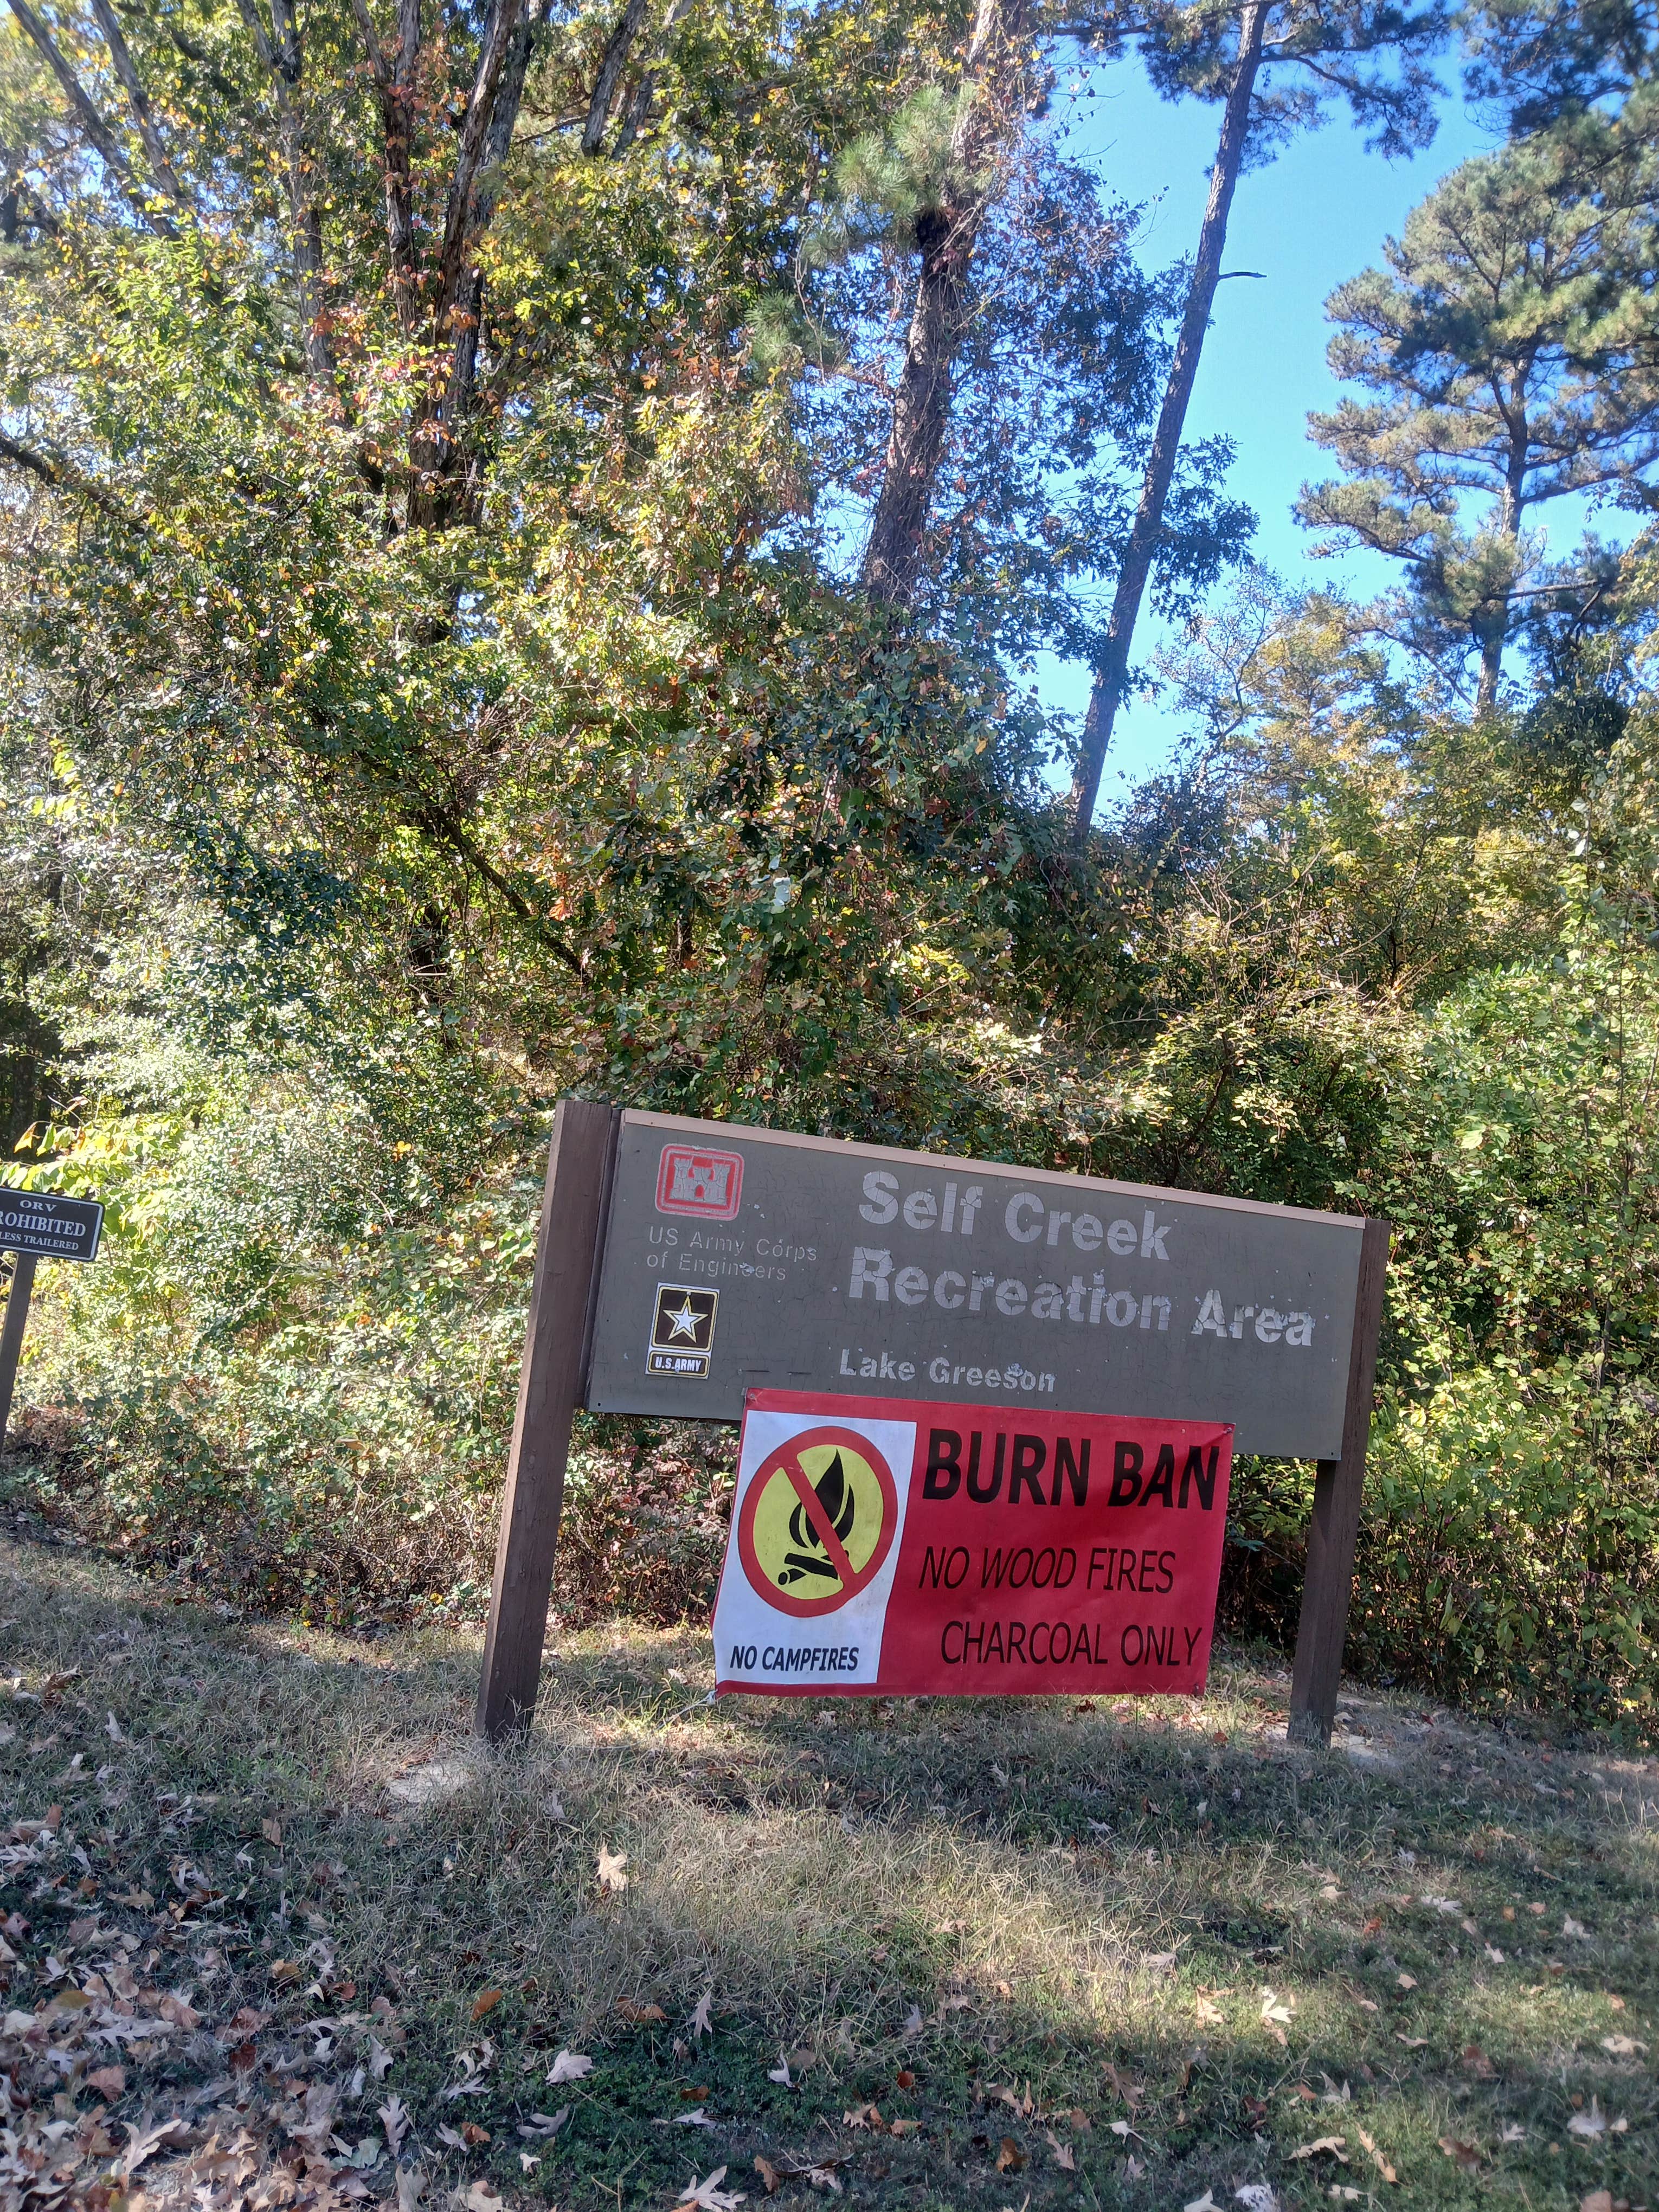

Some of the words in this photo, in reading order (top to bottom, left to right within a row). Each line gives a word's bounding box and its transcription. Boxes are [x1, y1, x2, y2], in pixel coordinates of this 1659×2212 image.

[20, 1200, 57, 1212] ORV
[859, 1170, 984, 1236] Self
[1004, 1191, 1172, 1261] Creek
[23, 1235, 79, 1250] TRAILERED
[649, 1226, 679, 1246] US
[690, 1231, 744, 1256] Army
[756, 1238, 817, 1262] Corps
[647, 1251, 668, 1268] of
[679, 1253, 786, 1280] Engineers
[848, 1246, 1173, 1330] Recreation
[1191, 1289, 1316, 1346] Area
[839, 1348, 916, 1382] Lake
[929, 1356, 1057, 1393] Greeson
[922, 1429, 1090, 1507] BURN
[1108, 1441, 1219, 1510] BAN
[918, 1546, 970, 1589] NO
[981, 1548, 1077, 1589] WOOD
[1086, 1549, 1177, 1594] FIRES
[729, 1646, 757, 1670] NO
[761, 1647, 859, 1672] CAMPFIRES
[941, 1621, 1108, 1667] CHARCOAL
[1120, 1624, 1203, 1666] ONLY
